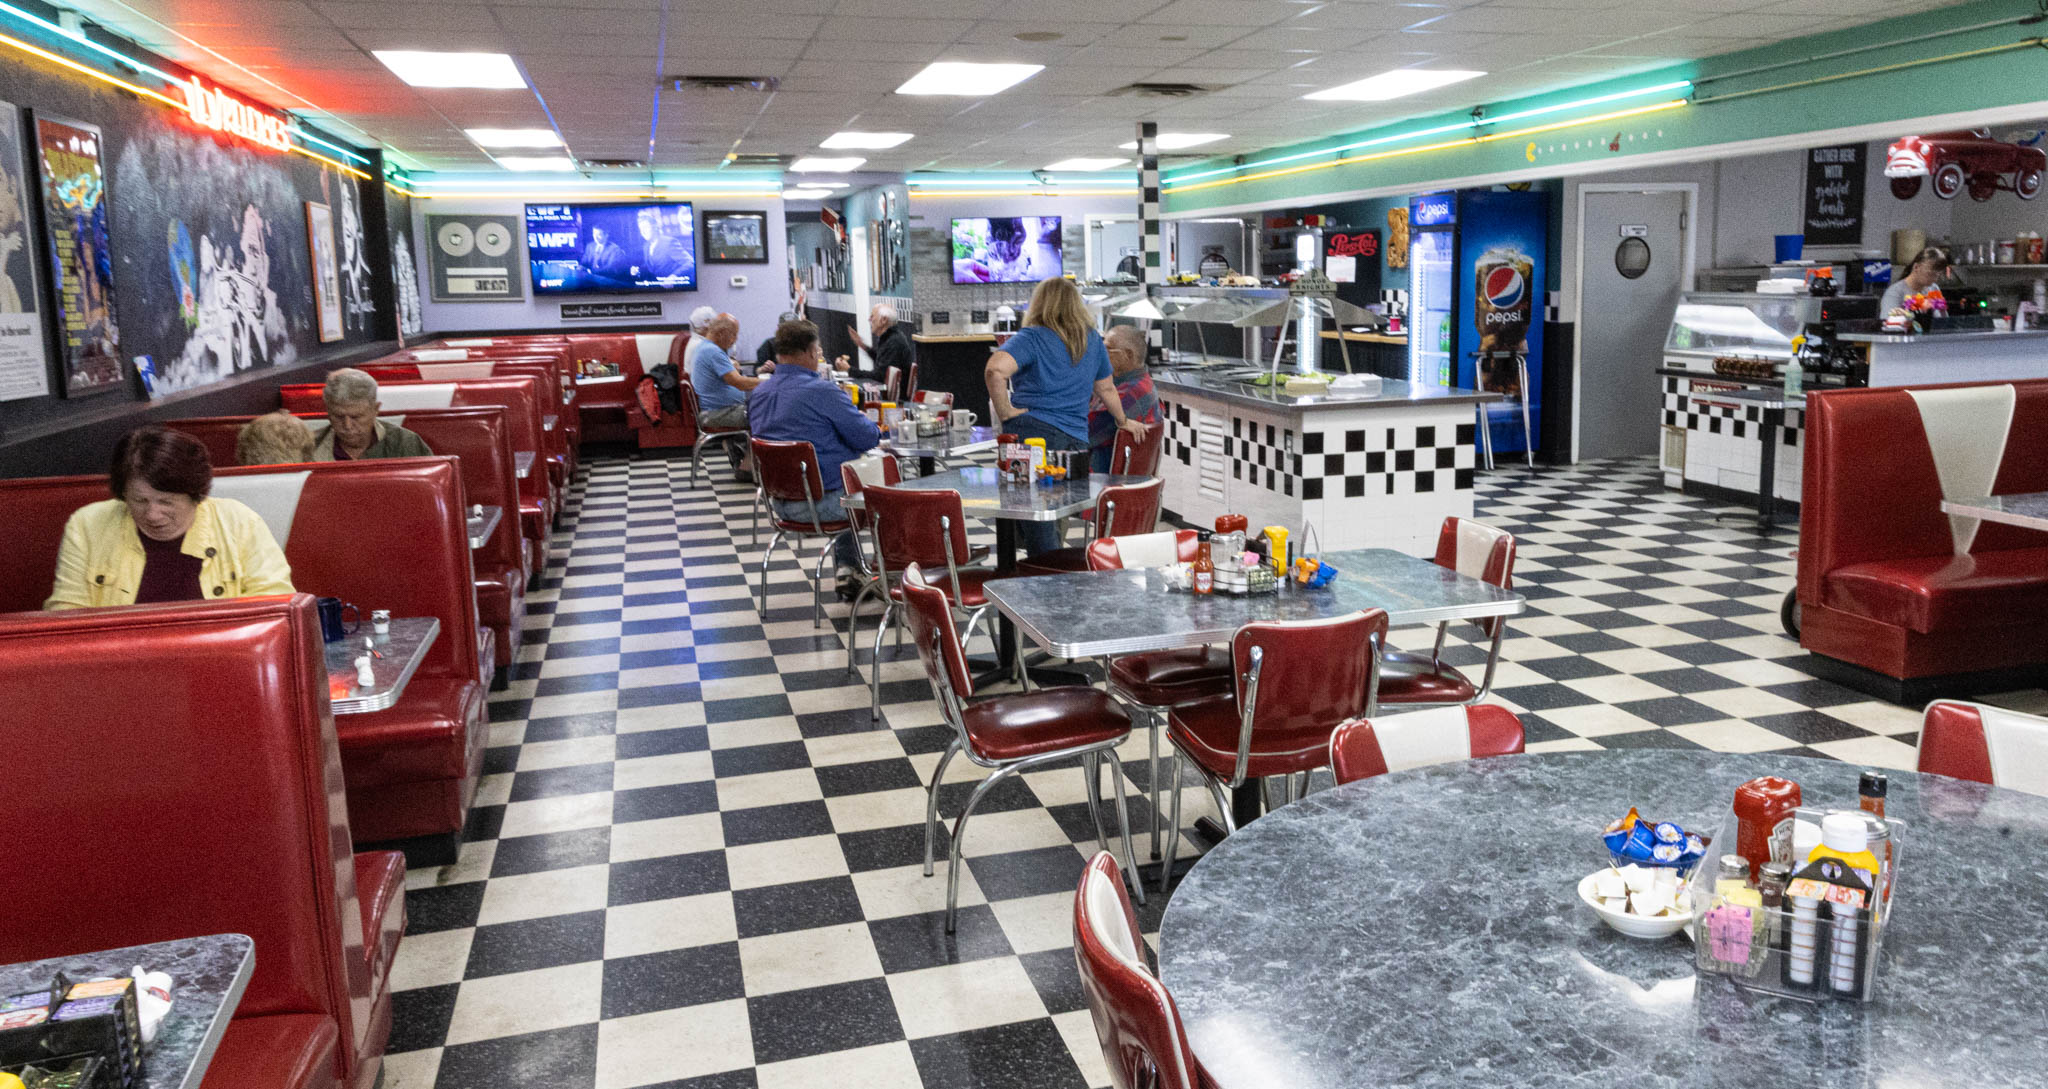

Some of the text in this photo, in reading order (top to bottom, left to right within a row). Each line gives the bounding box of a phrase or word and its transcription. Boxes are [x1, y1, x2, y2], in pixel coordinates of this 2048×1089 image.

[1825, 165, 1843, 178] WITH
[1427, 202, 1449, 218] pepsi
[538, 232, 578, 249] WPT
[1485, 310, 1523, 325] pepsi
